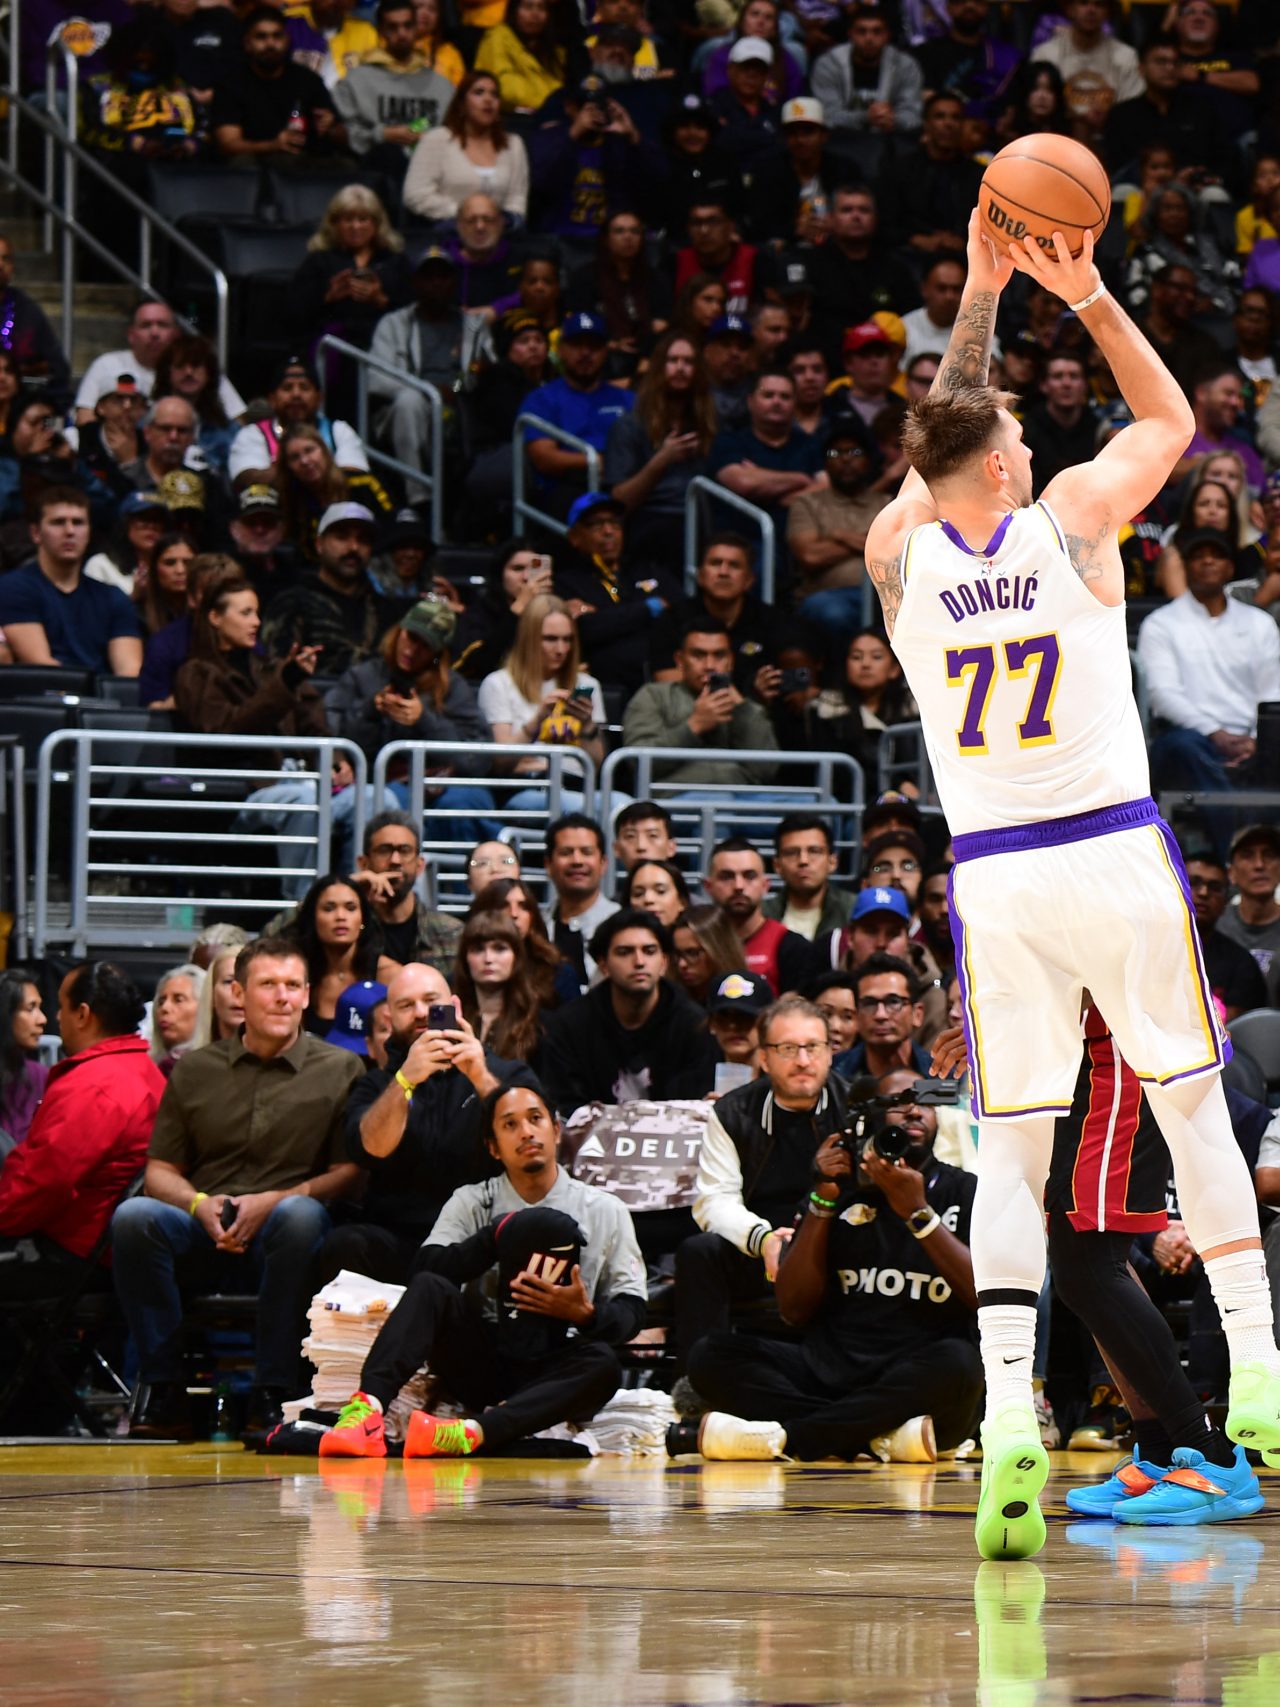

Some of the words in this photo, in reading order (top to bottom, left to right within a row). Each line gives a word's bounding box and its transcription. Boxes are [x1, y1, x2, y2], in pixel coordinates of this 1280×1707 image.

[939, 569, 1038, 623] DONČIĆ
[944, 631, 1063, 756] 77
[615, 1136, 702, 1160] DELT
